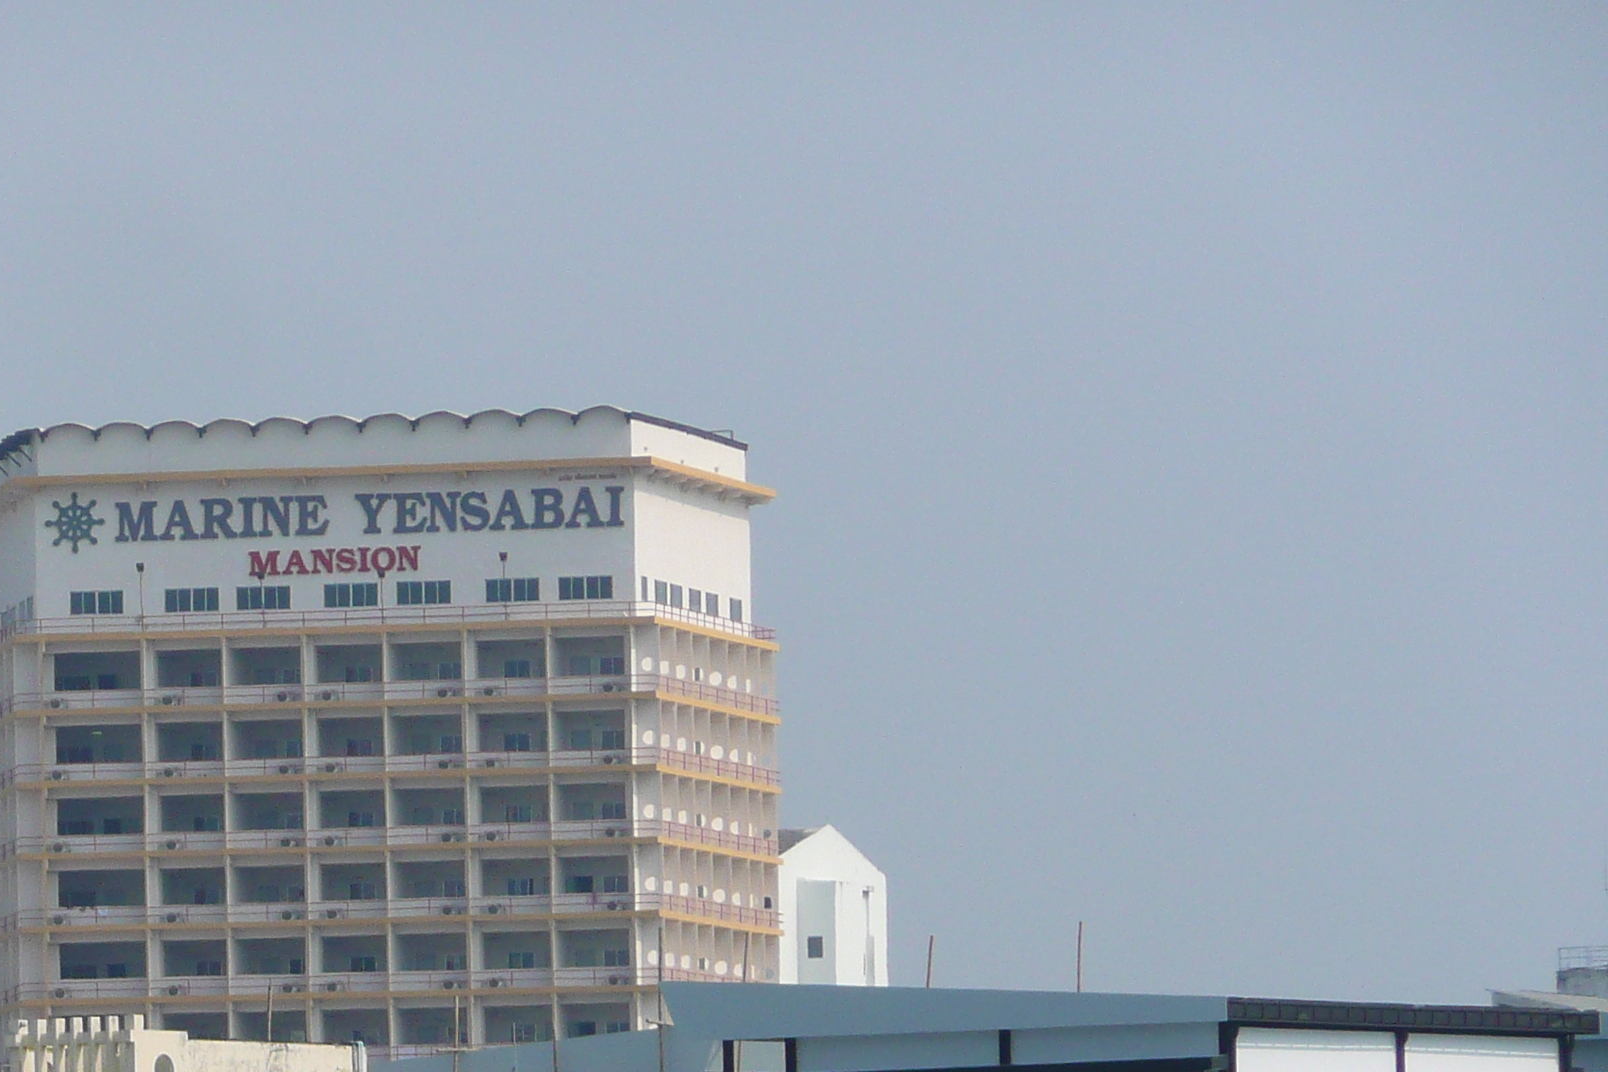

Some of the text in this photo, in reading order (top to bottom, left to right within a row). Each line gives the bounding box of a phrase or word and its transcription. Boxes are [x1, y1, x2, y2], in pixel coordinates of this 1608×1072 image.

[114, 485, 625, 543] MARINE YENSABAI
[248, 545, 421, 577] MANSION
